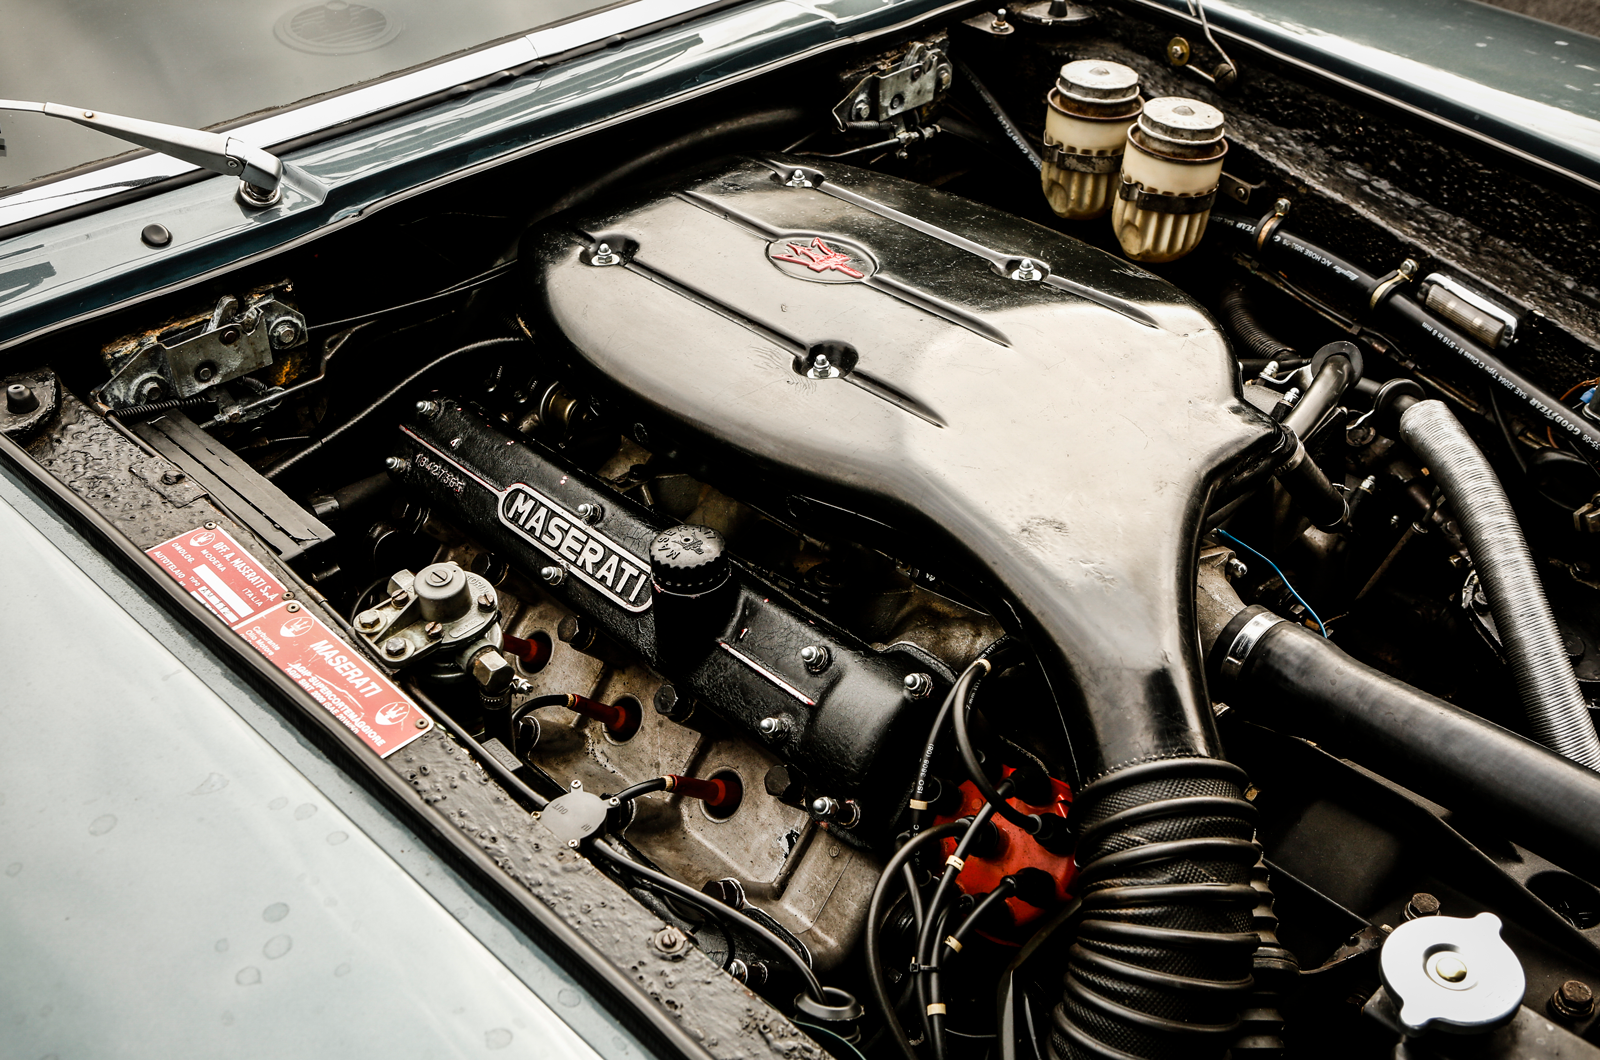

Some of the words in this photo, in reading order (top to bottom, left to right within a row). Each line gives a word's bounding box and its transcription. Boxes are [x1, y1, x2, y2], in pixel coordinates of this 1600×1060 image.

[1303, 246, 1322, 262] HOSE
[1464, 352, 1480, 365] Class
[1484, 365, 1499, 379] Type
[1514, 388, 1529, 400] SAE
[1529, 397, 1581, 436] GOODYEAR
[171, 542, 196, 564] OMOLOG.
[507, 492, 648, 602] MASERATI
[153, 550, 186, 579] AUTOTELAIO
[200, 549, 227, 572] MODENA
[242, 587, 264, 607] ITALIA
[230, 557, 266, 589] MASERATI
[189, 576, 201, 587] TIPO
[245, 629, 258, 641] Olio
[255, 638, 275, 656] Motore
[285, 667, 302, 680] AGIP
[298, 679, 314, 693] SINT
[310, 640, 383, 697] MASERATI
[253, 625, 280, 651] Carburante
[293, 662, 313, 677] AGIP
[308, 674, 387, 747] SUPERCORTEMAGGIORE
[916, 778, 926, 794] ISO
[925, 743, 935, 759] (08)
[551, 803, 568, 815] OUT
